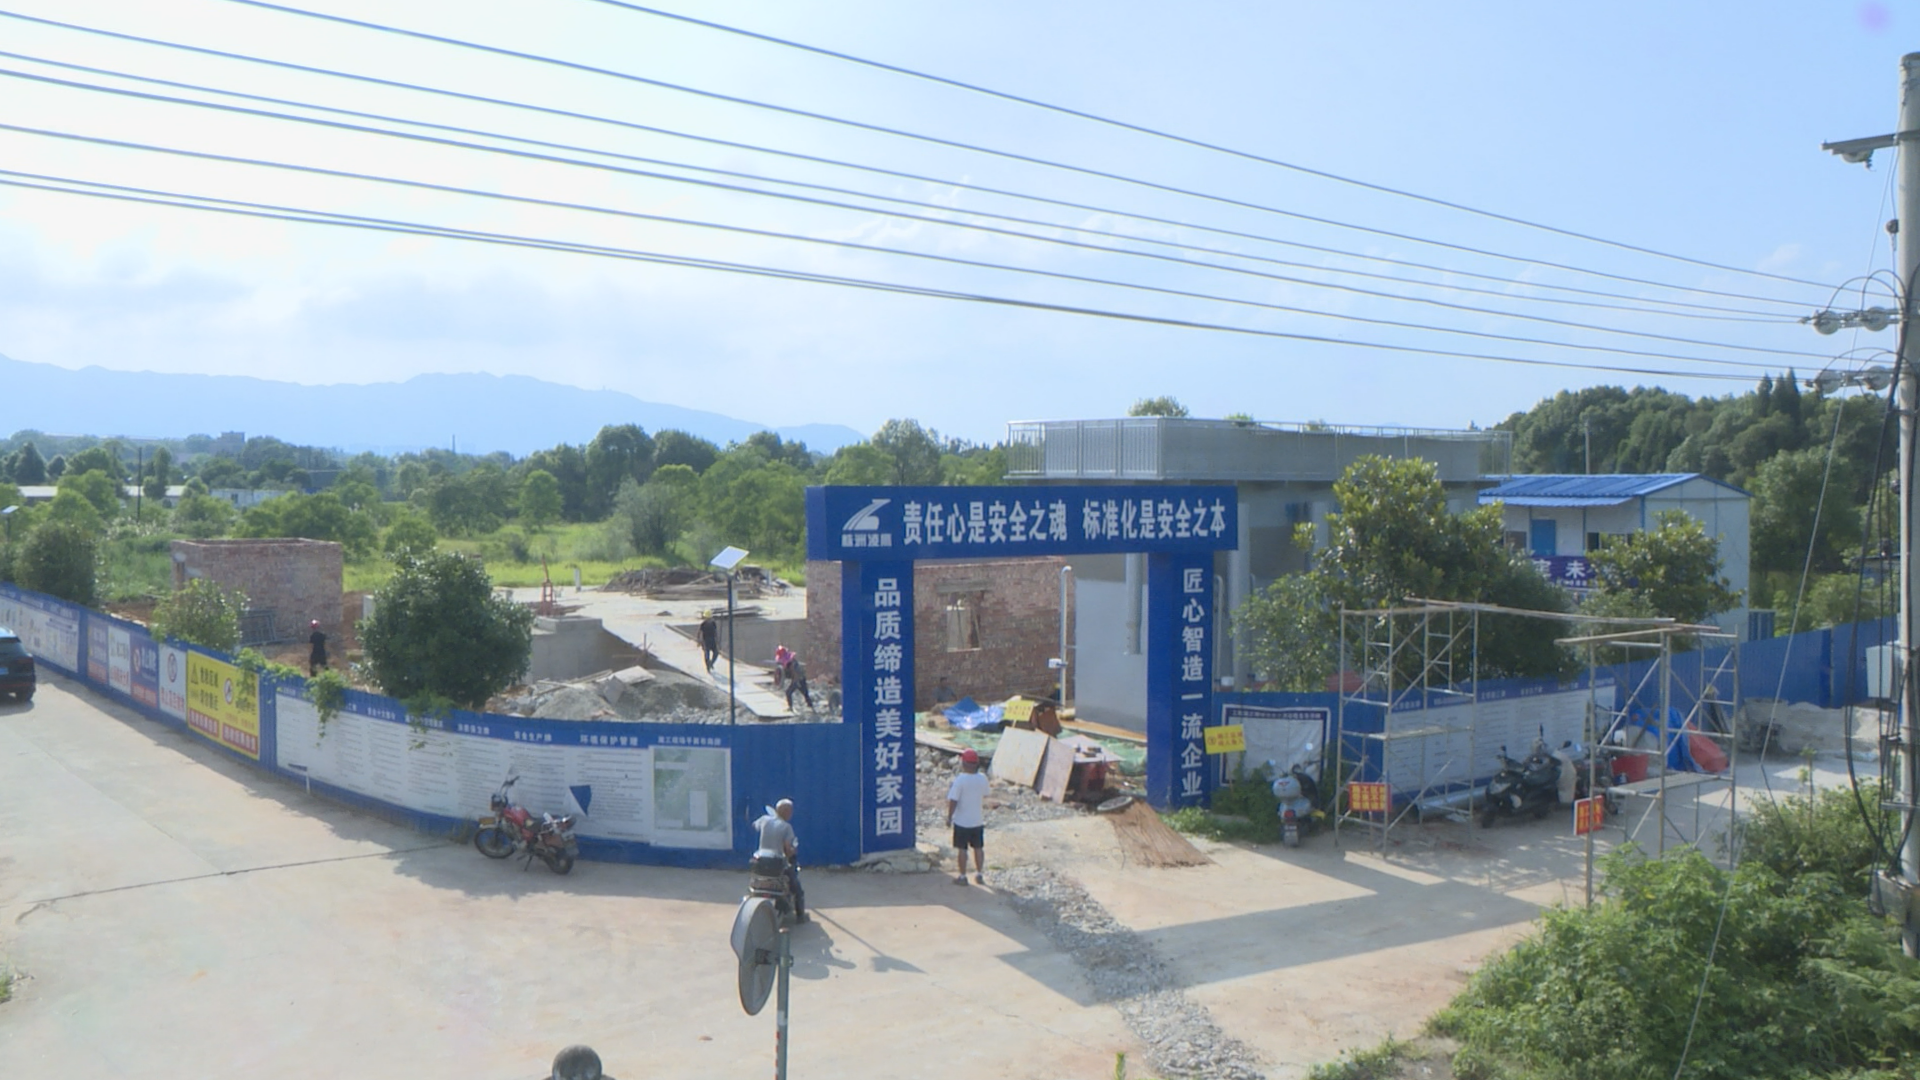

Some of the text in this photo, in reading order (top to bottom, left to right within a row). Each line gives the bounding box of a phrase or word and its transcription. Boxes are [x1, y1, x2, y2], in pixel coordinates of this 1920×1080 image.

[903, 498, 1226, 544] 责任心是安全之魂 标准化是安全之本
[874, 578, 904, 836] 品质缔造美好家园
[1181, 568, 1205, 797] 匠心智造一流企业
